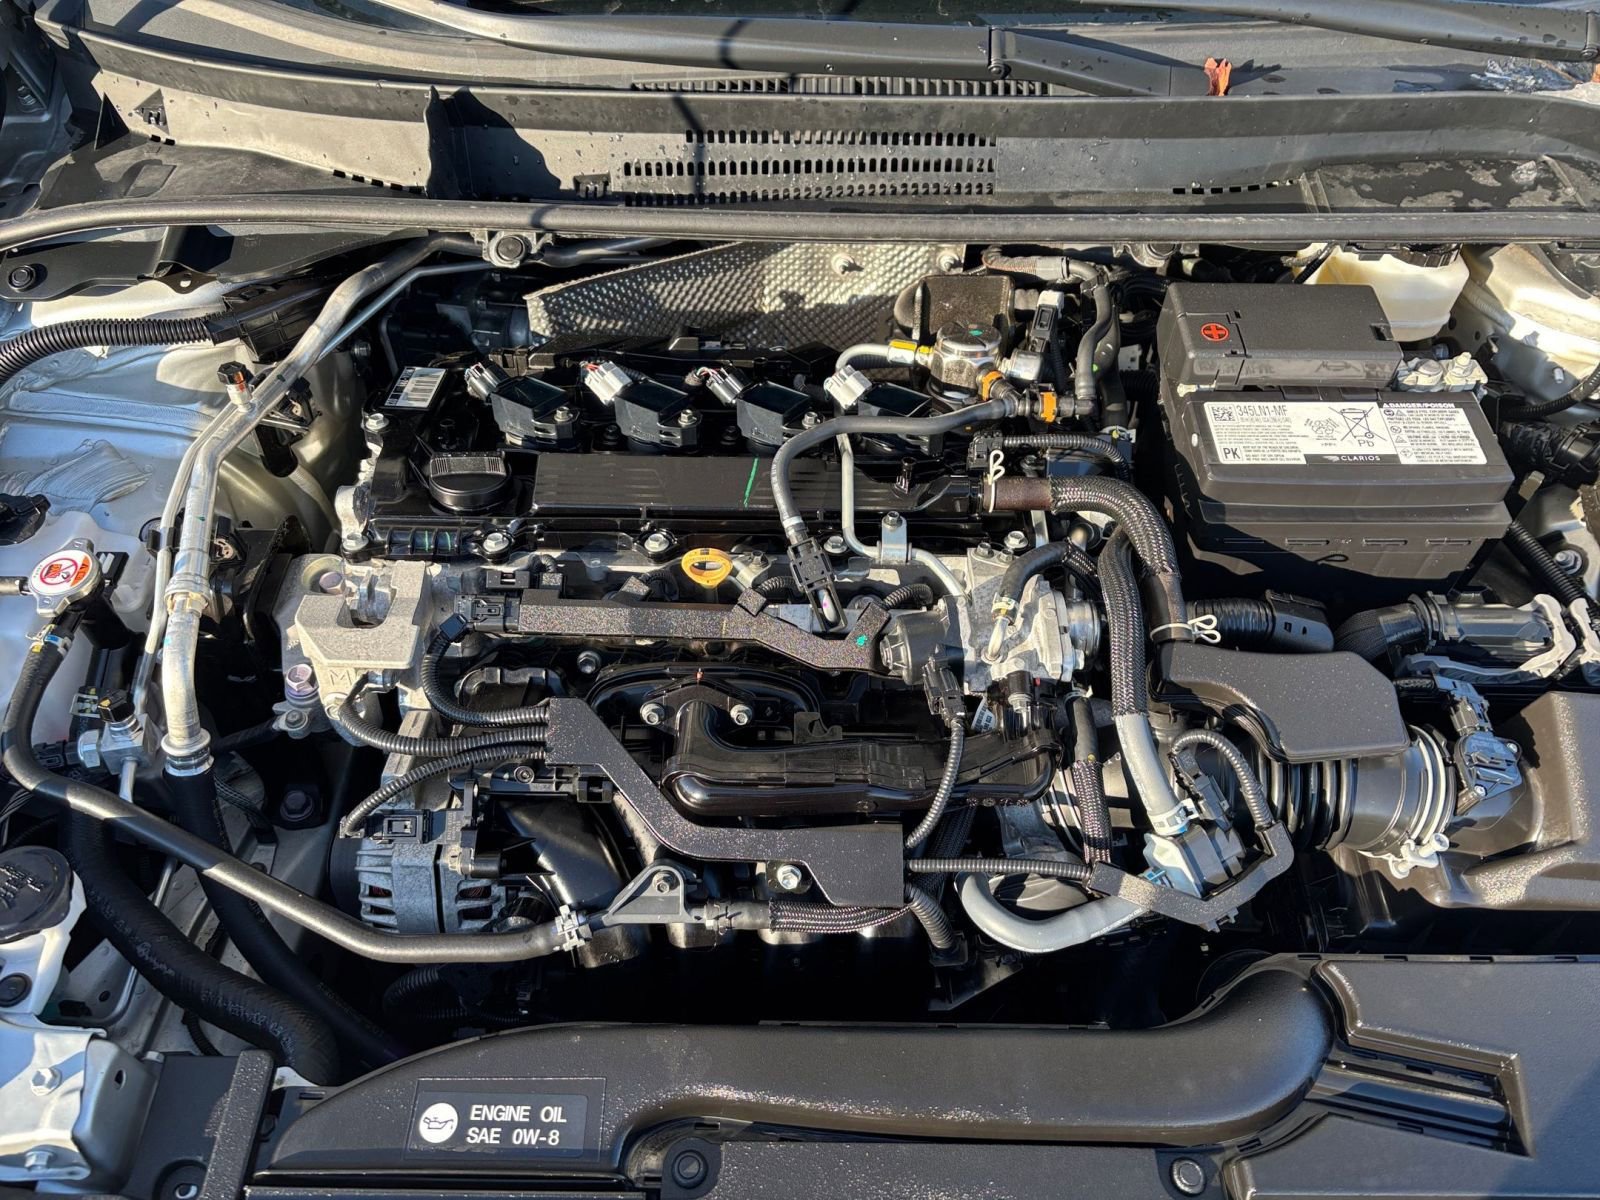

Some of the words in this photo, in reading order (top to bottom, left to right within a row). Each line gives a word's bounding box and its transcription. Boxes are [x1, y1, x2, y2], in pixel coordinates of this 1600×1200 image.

[1236, 405, 1288, 417] 345LN1-MF
[1357, 439, 1375, 447] Pb
[1222, 447, 1241, 460] PK
[469, 1104, 531, 1122] ENGINE
[540, 1106, 568, 1123] OIL
[466, 1127, 502, 1144] SAE
[511, 1128, 560, 1146] 0W-8
